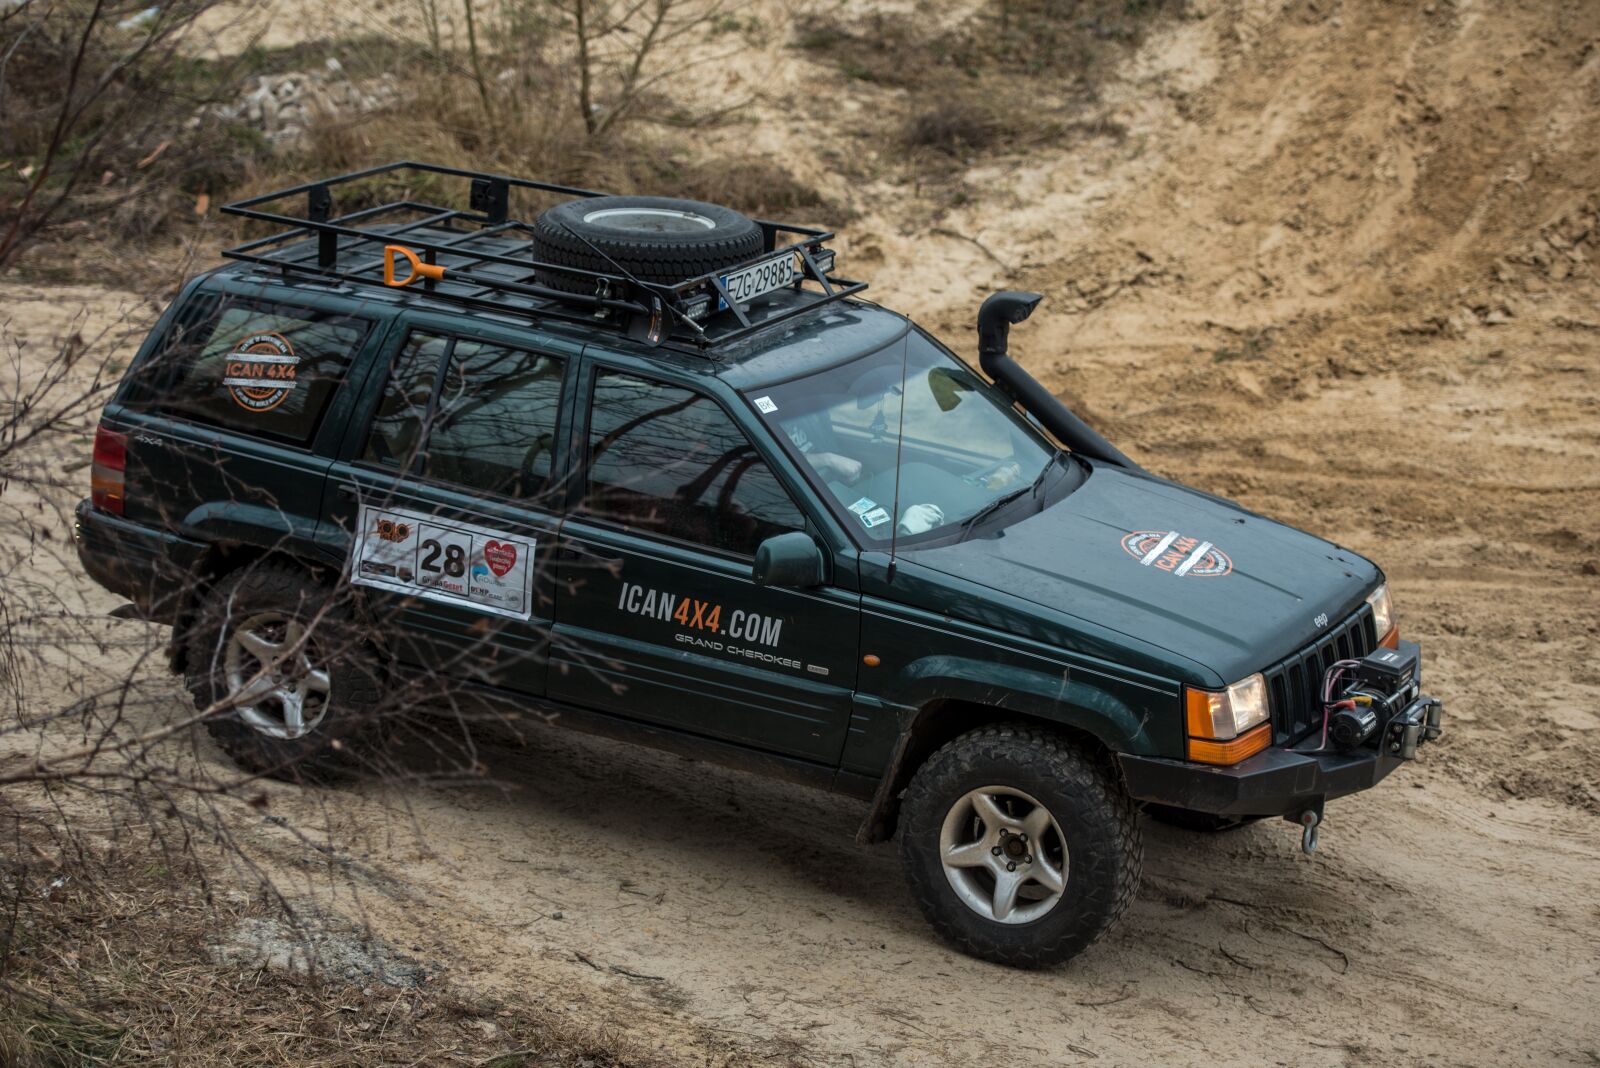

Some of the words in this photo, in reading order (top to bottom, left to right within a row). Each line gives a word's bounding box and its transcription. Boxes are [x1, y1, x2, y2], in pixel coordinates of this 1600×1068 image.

[727, 272, 752, 300] EZG
[755, 257, 793, 293] 29885
[225, 362, 264, 377] ICAN
[266, 363, 296, 379] 4X4
[421, 538, 465, 578] 28
[618, 582, 782, 648] ICAN4X4.COM
[674, 633, 724, 651] GRAND
[726, 645, 801, 669] CHEROKEE
